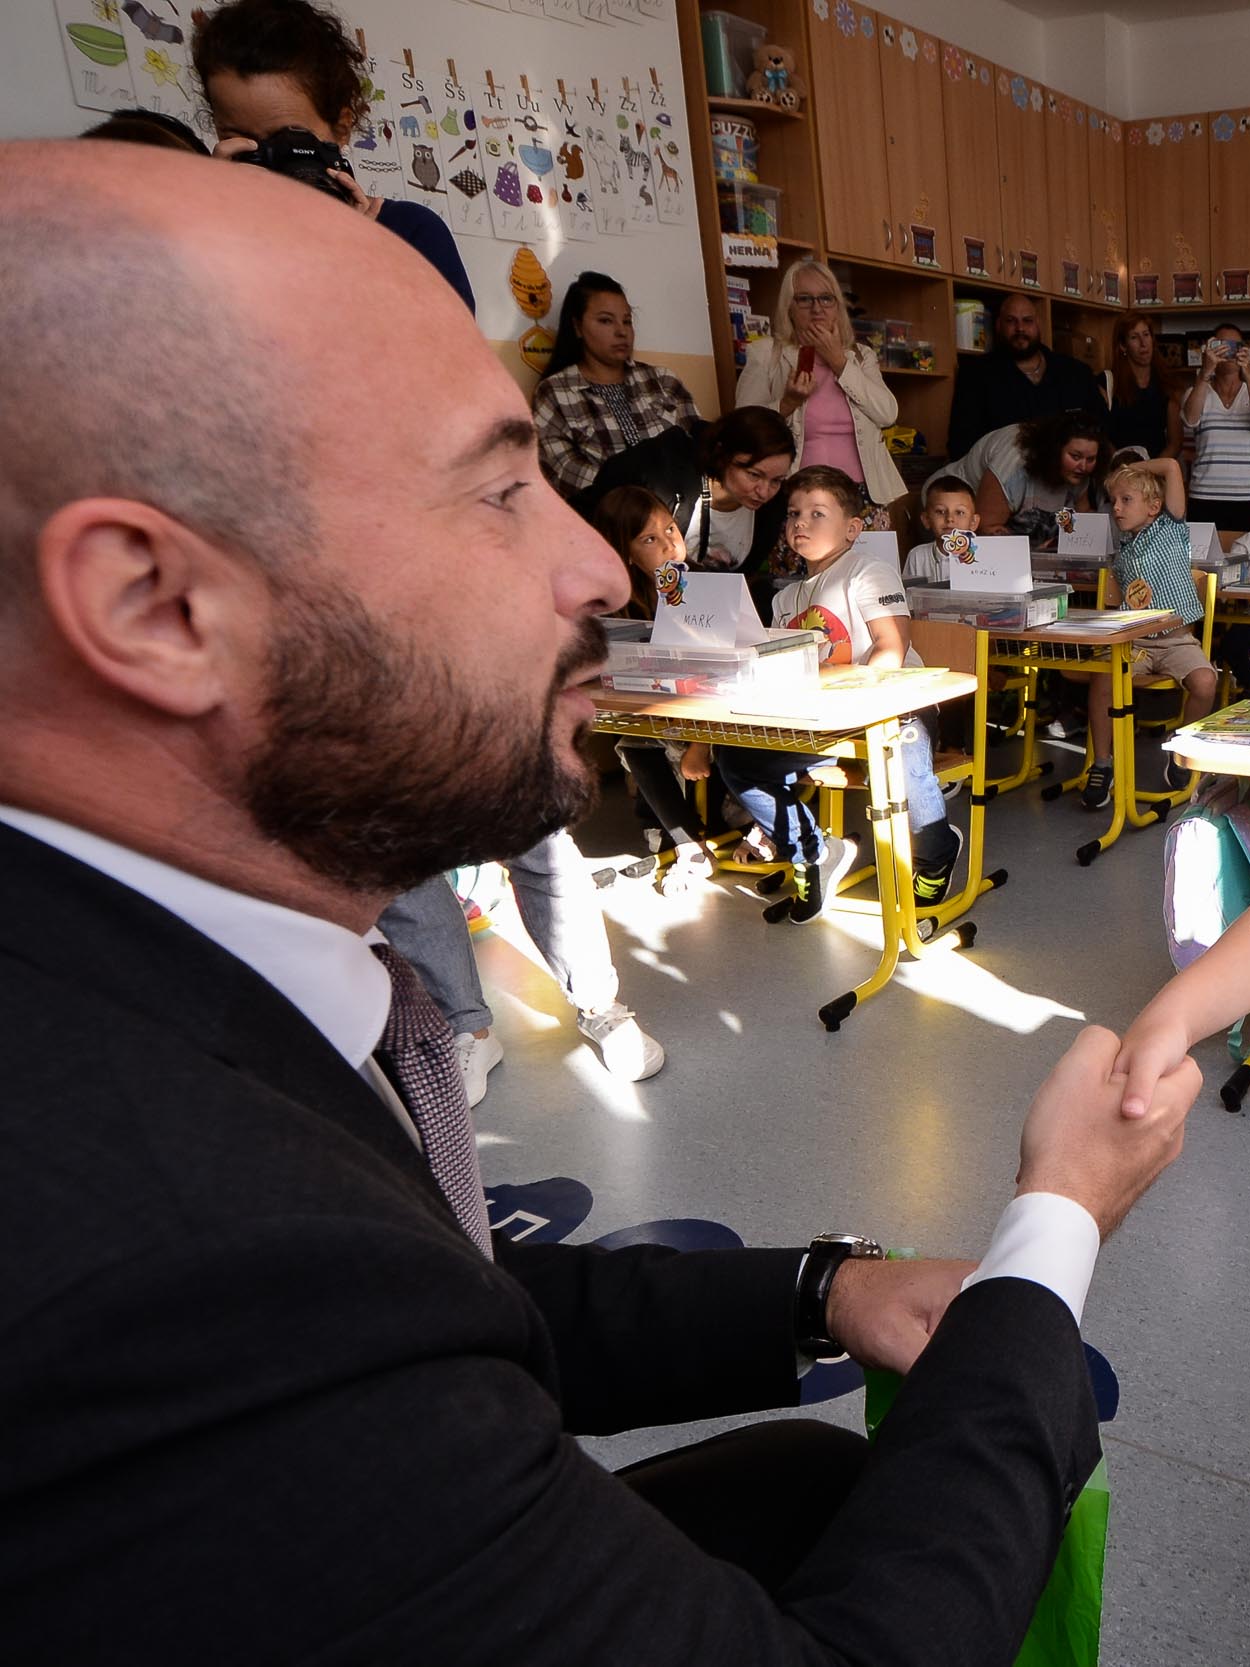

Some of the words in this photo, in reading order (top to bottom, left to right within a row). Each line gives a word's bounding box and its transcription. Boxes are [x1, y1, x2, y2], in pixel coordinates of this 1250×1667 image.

[401, 72, 424, 92] Ss
[444, 78, 466, 102] Šš
[483, 92, 504, 111] Tt
[516, 94, 541, 113] Uu
[586, 95, 606, 117] Yy
[619, 96, 638, 113] Zz
[728, 244, 771, 257] HERNA
[683, 613, 715, 628] MARK
